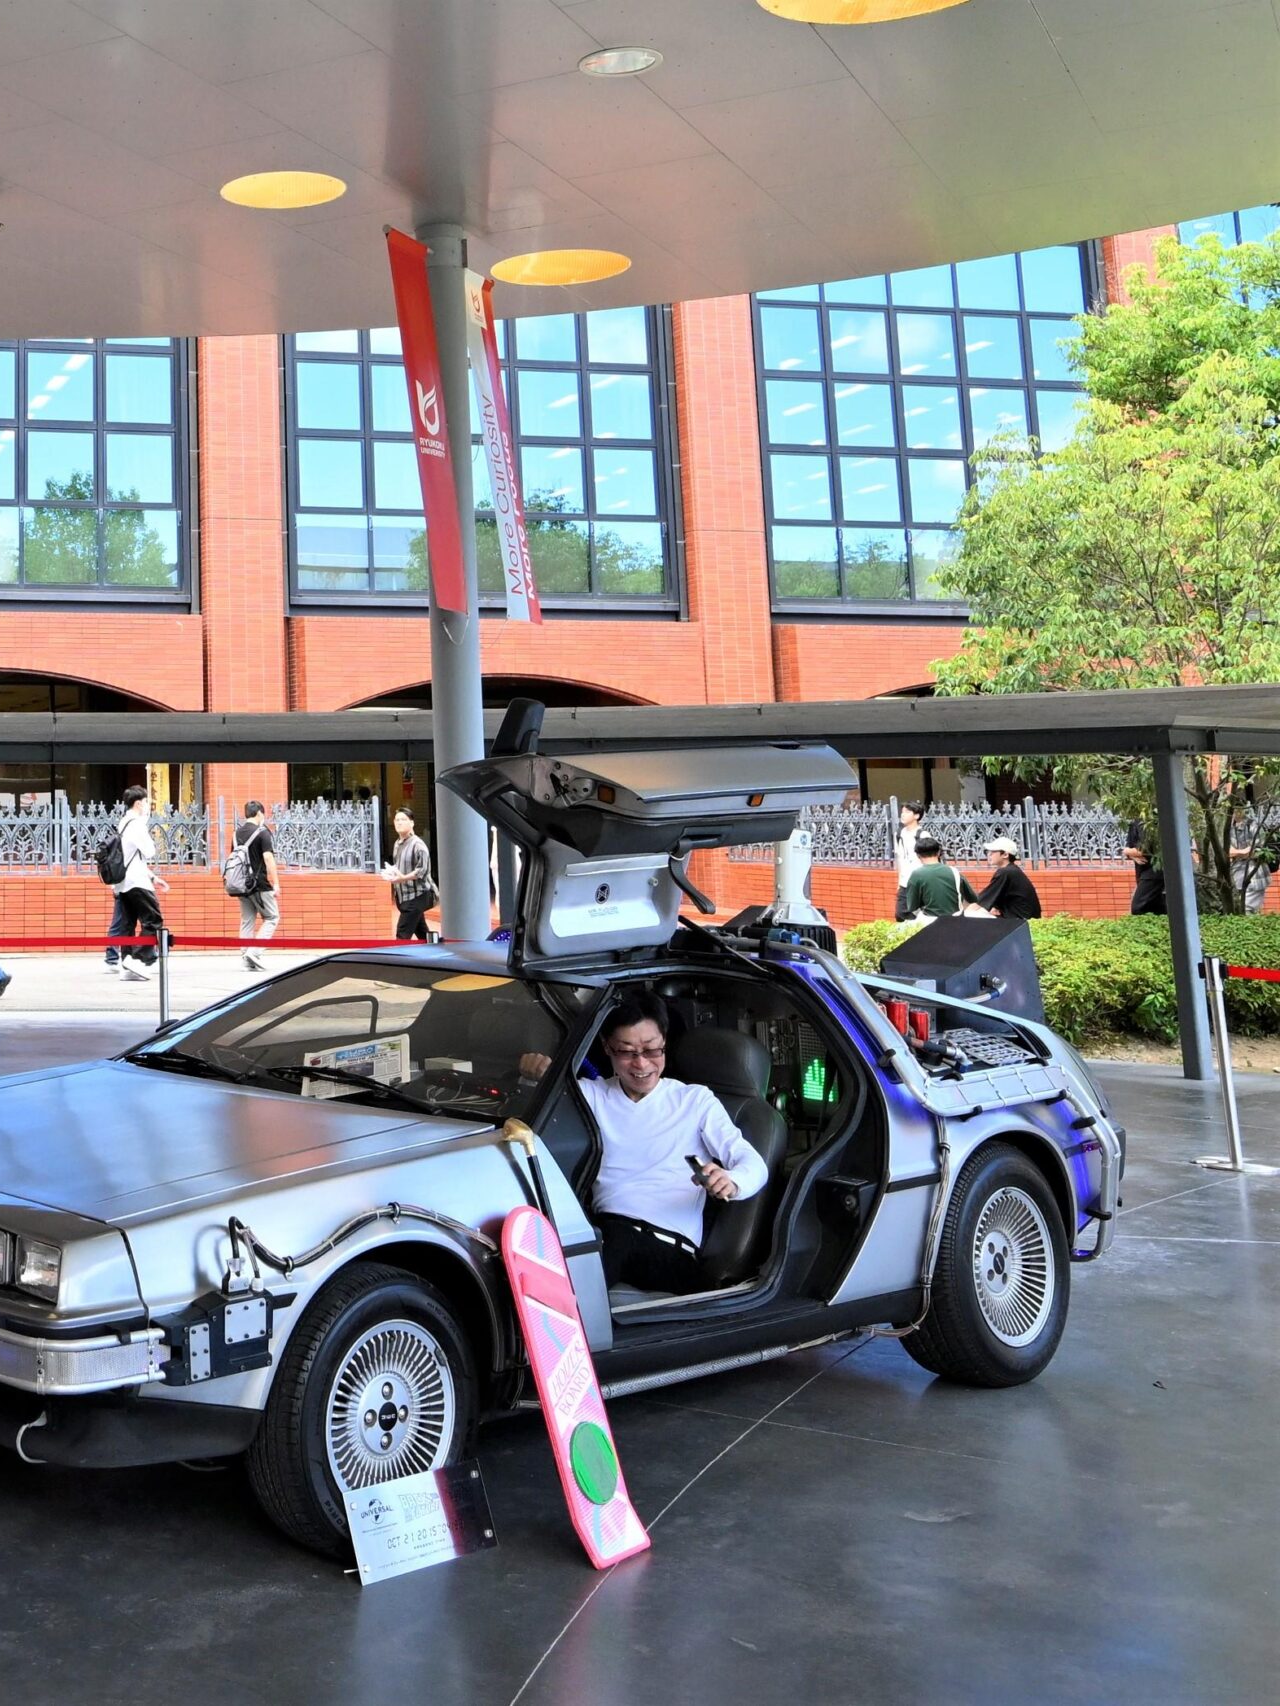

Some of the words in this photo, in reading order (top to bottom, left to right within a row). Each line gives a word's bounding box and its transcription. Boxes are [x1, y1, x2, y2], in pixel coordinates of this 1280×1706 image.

[482, 394, 510, 514] Curiosity
[505, 522, 523, 595] More
[558, 1366, 590, 1416] BOARD
[360, 1506, 394, 1519] UNIVERSAL
[387, 1536, 400, 1549] OCT
[404, 1532, 414, 1544] 21
[418, 1526, 437, 1541] 2015
